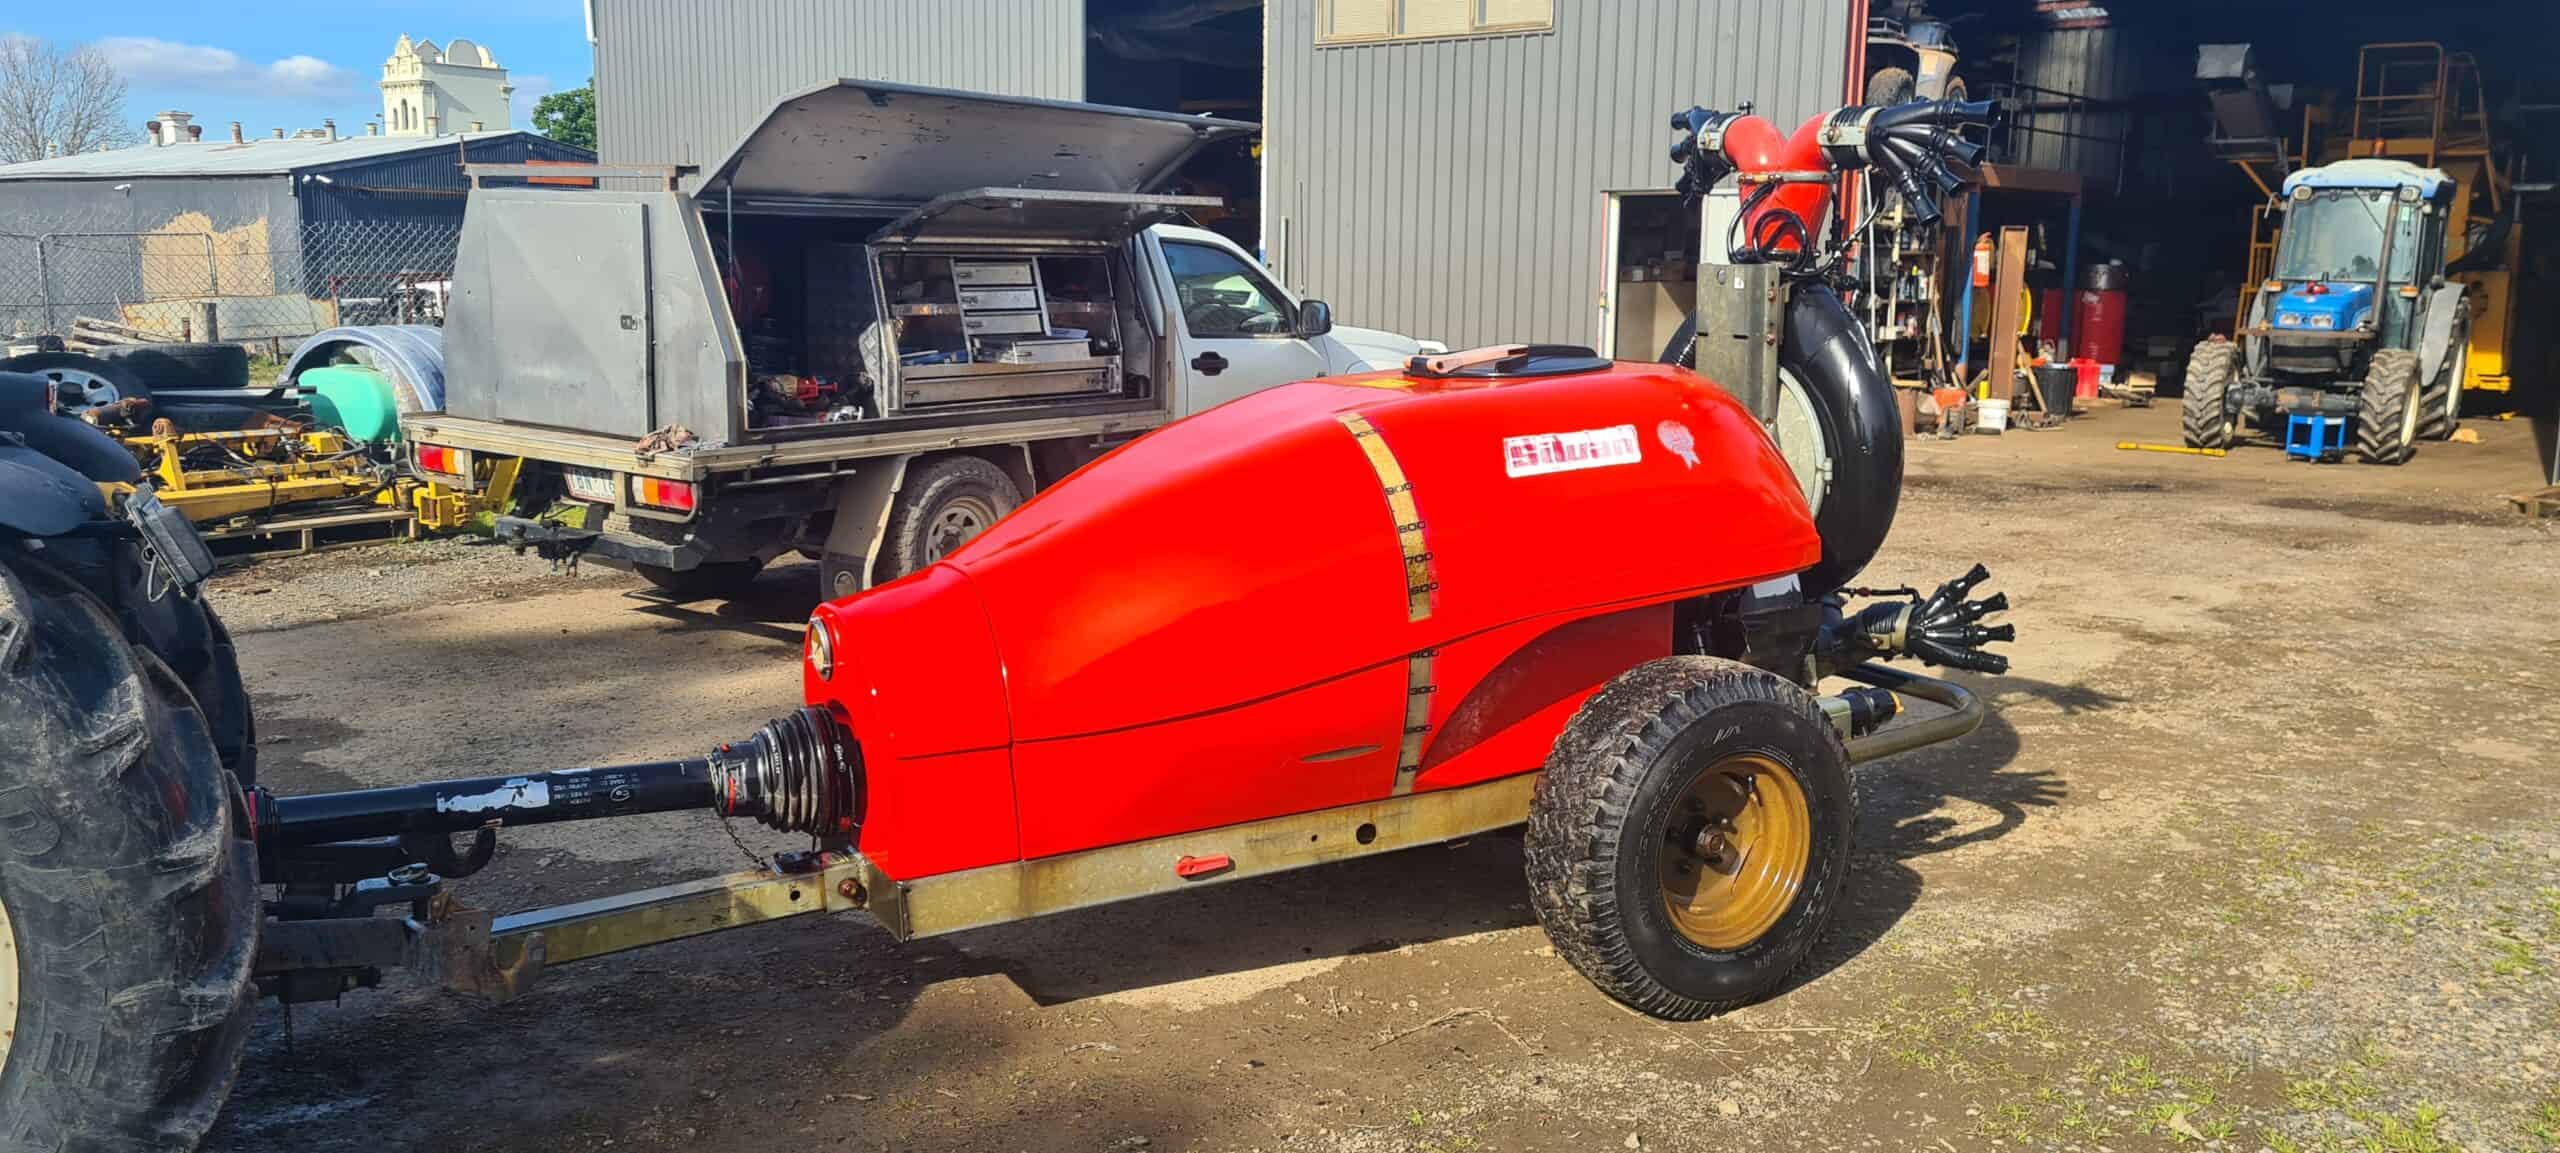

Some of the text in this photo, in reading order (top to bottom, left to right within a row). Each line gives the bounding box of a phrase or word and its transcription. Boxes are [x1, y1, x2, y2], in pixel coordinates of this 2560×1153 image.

[1385, 481, 1414, 495] 900
[1399, 521, 1425, 533] 800
[1406, 552, 1433, 565] 700
[1410, 582, 1438, 595] 600
[1409, 685, 1437, 695] 300
